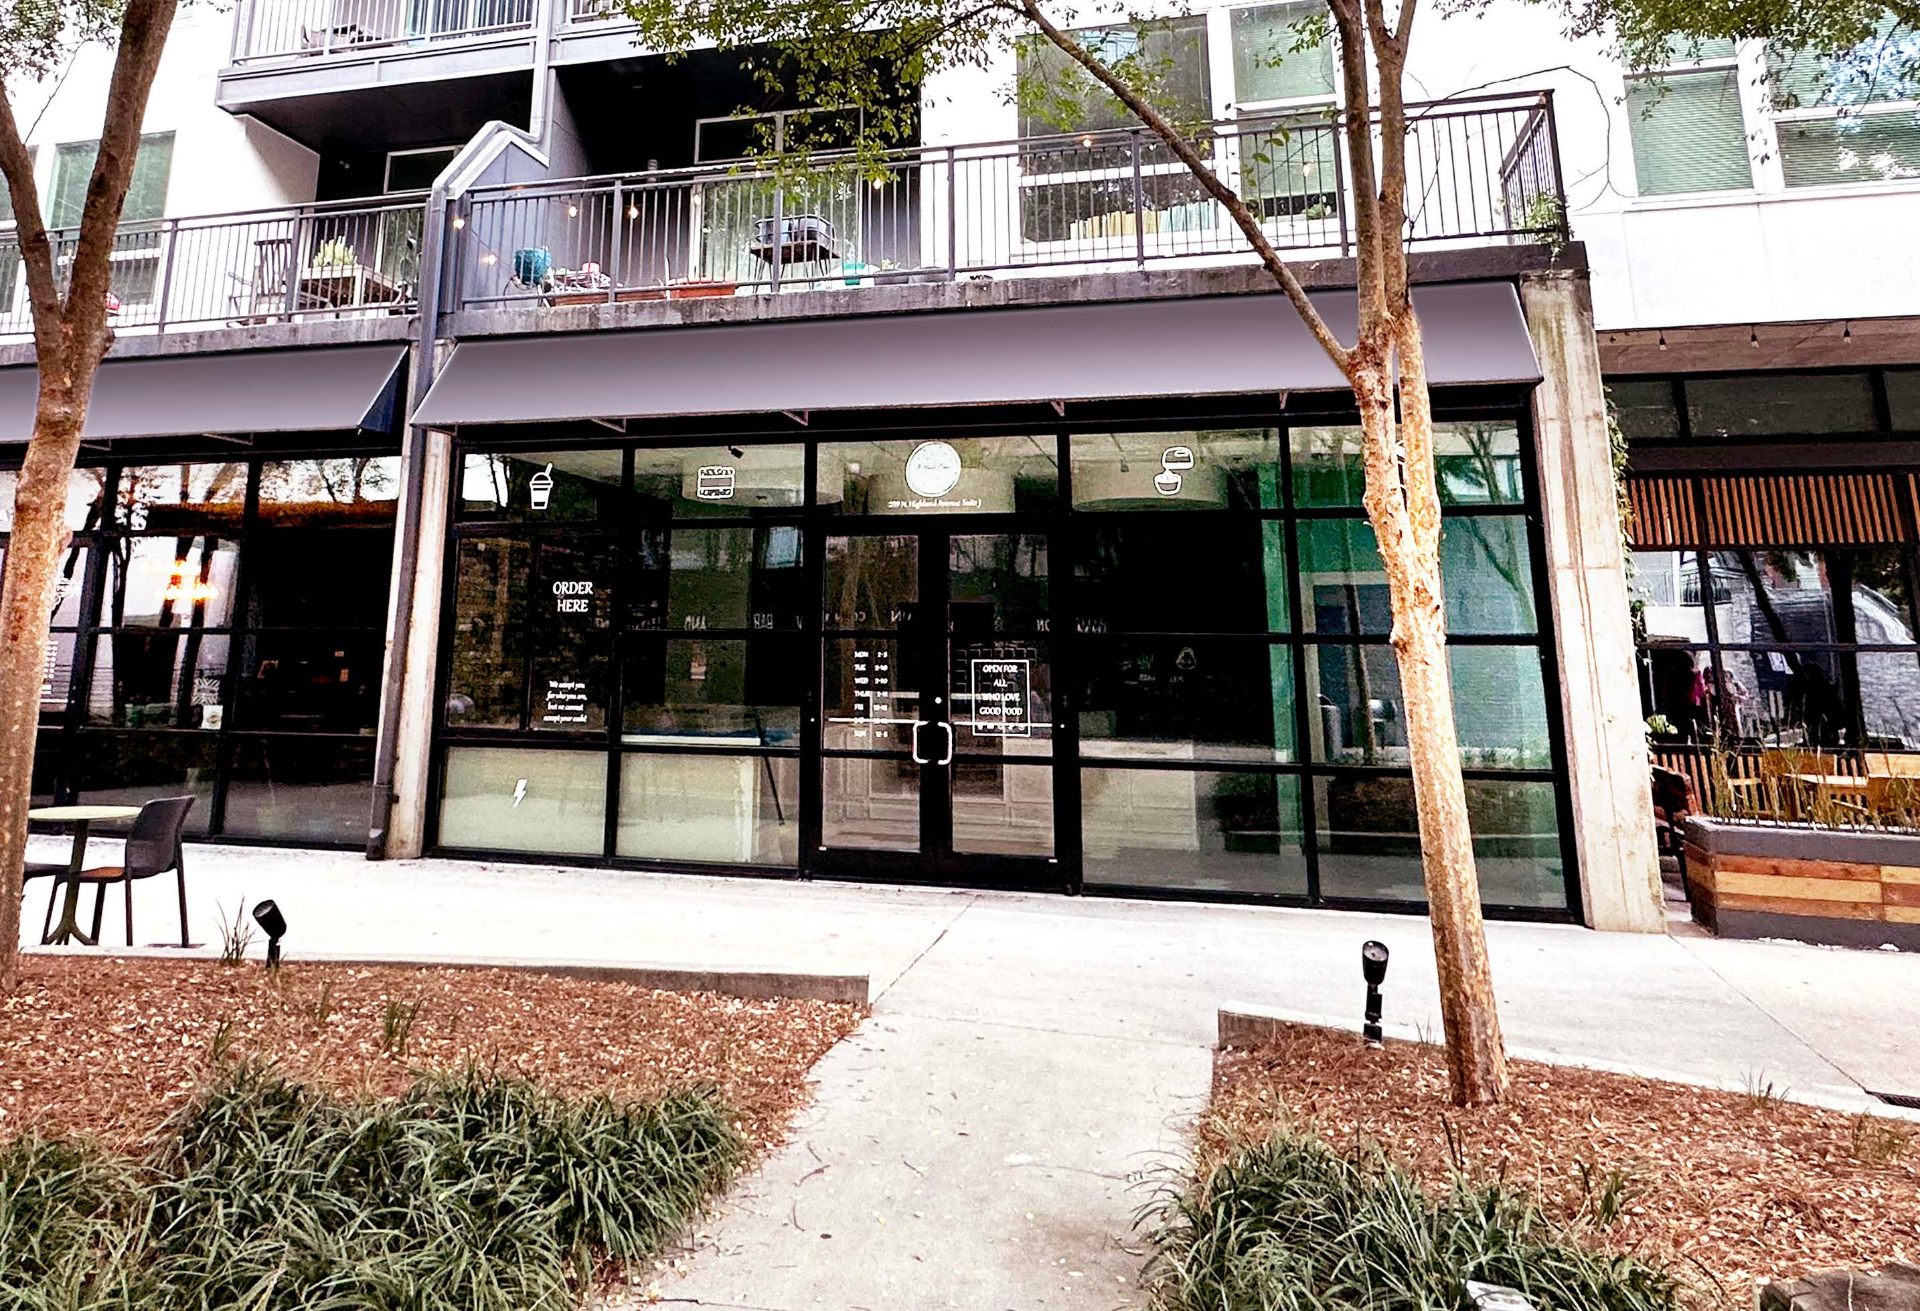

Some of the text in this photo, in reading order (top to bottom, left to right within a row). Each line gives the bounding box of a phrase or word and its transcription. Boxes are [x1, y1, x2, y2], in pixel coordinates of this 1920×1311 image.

[552, 581, 593, 594] ORDER
[557, 599, 589, 612] HERE
[983, 665, 1018, 673] OPEN FOR
[993, 679, 1008, 687] ALL
[981, 693, 1021, 701] WHO LOVE
[979, 706, 1023, 715] GOOD FOOD
